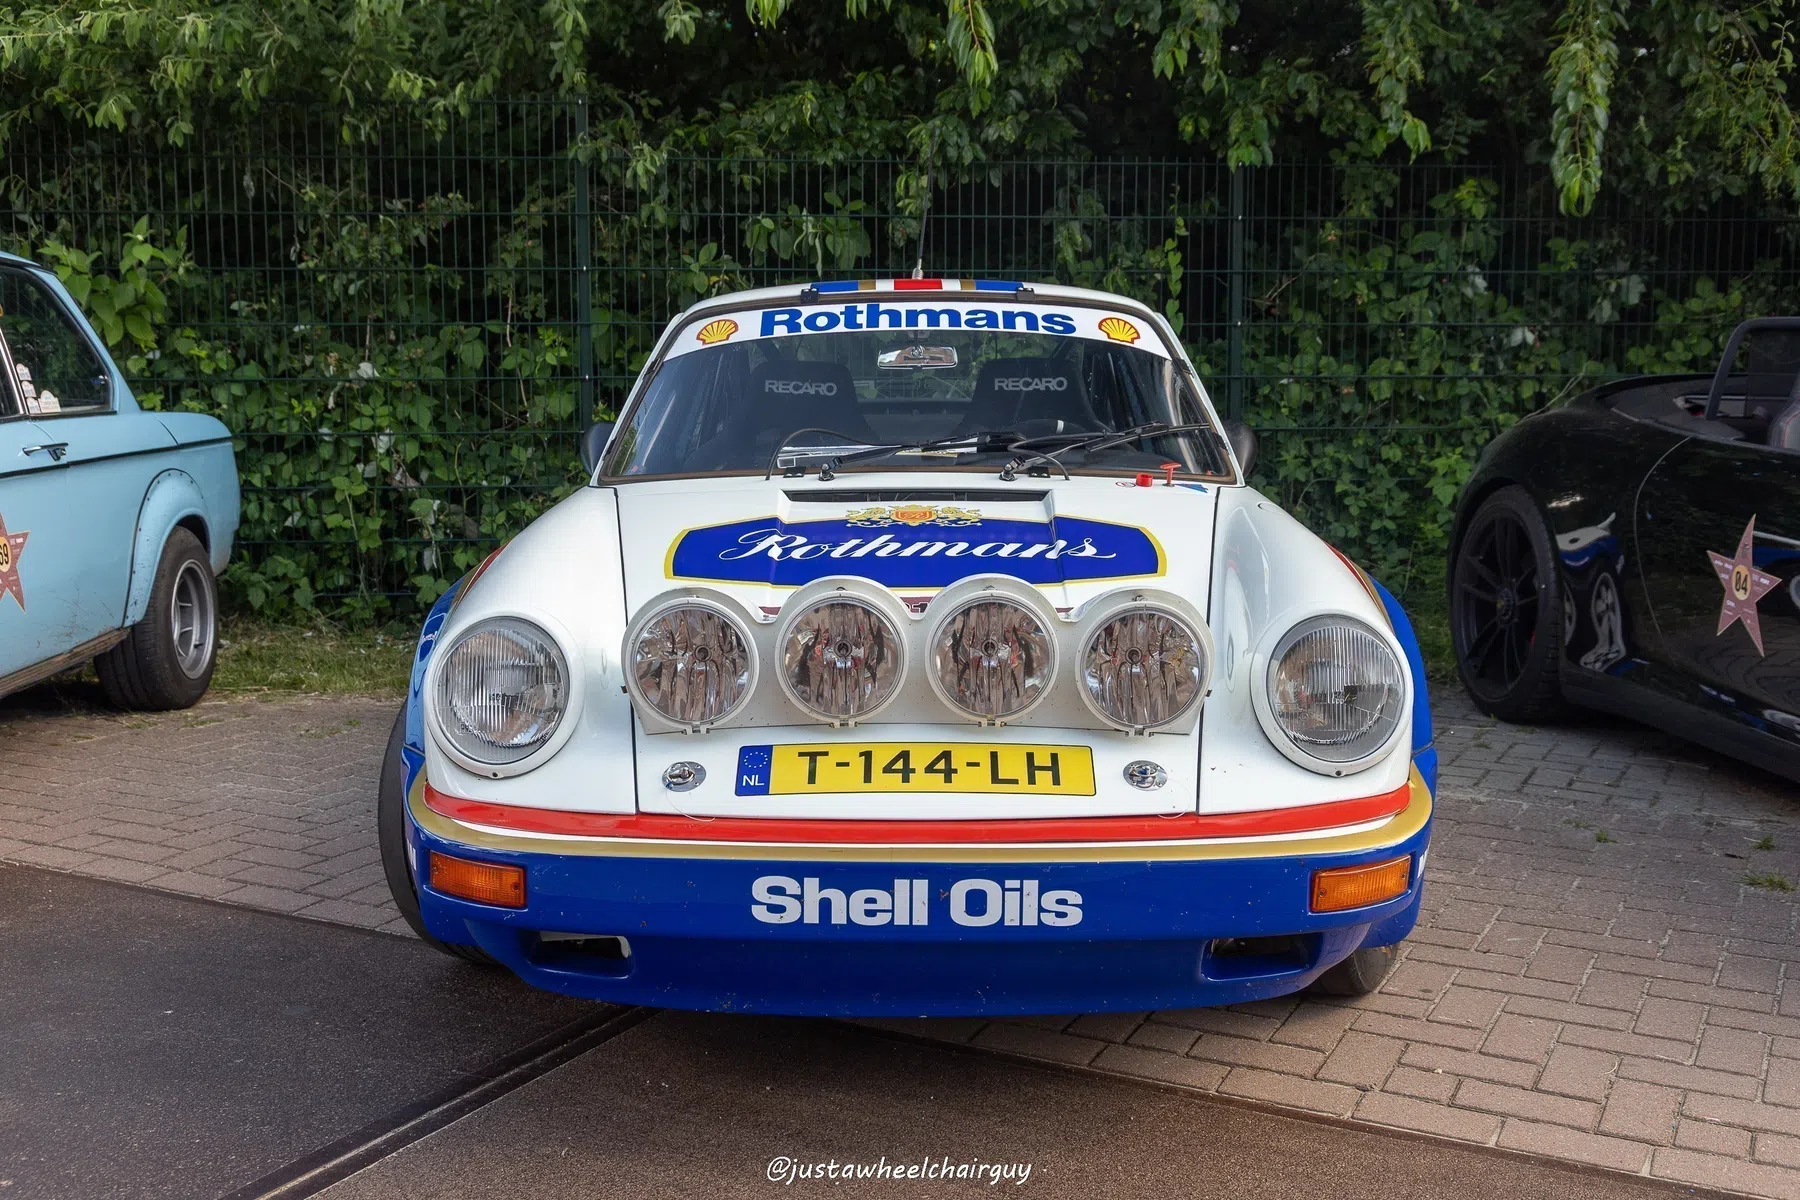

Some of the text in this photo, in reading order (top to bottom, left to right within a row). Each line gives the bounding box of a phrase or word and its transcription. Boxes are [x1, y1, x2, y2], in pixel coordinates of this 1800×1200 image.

[760, 303, 1077, 337] Rothmans
[764, 380, 838, 398] RECARO
[994, 376, 1068, 392] RECARO
[718, 529, 1117, 562] Rothmans
[742, 775, 765, 787] NL
[797, 749, 1062, 787] T-144-LH
[751, 875, 1083, 927] Shell Oils
